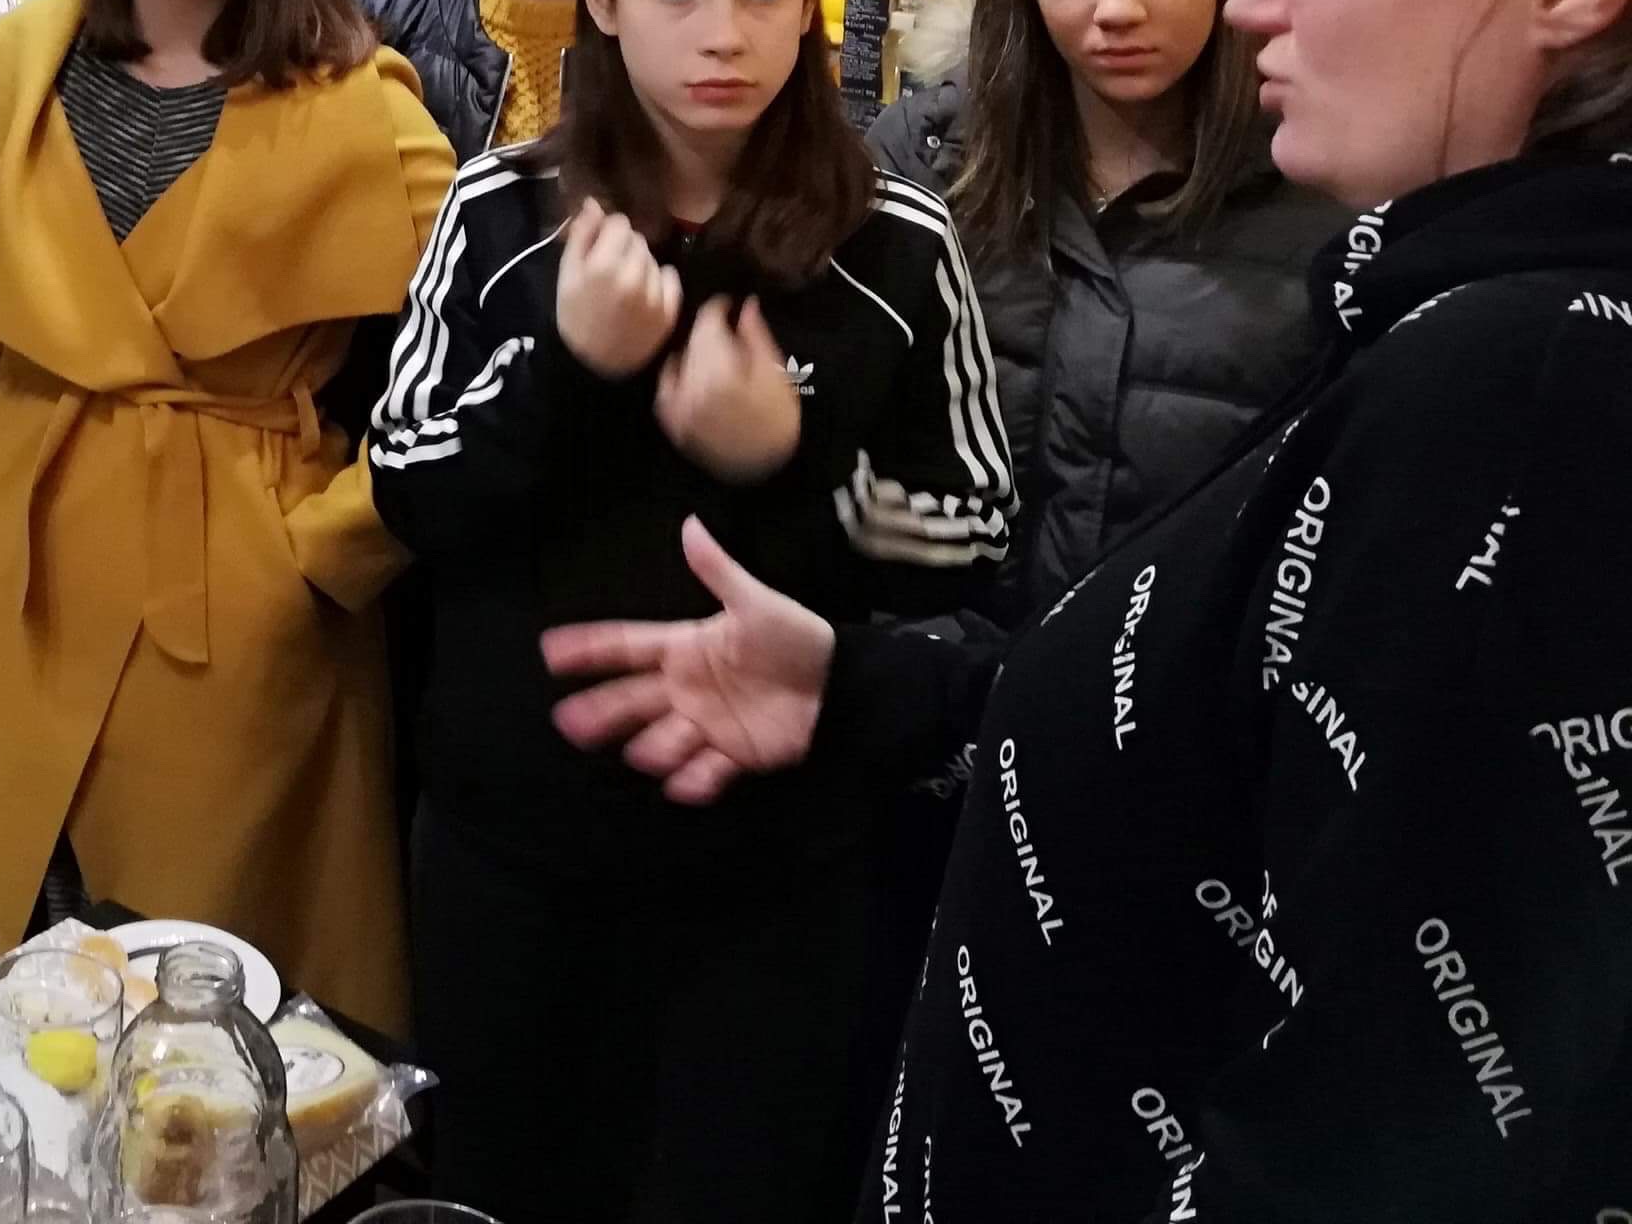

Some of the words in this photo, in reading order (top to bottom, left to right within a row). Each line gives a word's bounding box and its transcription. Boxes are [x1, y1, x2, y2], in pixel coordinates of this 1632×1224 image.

[999, 737, 1065, 947] ORIGINAL
[956, 944, 1032, 1148] ORIGINAL
[1415, 916, 1533, 1139] ORIGINAL
